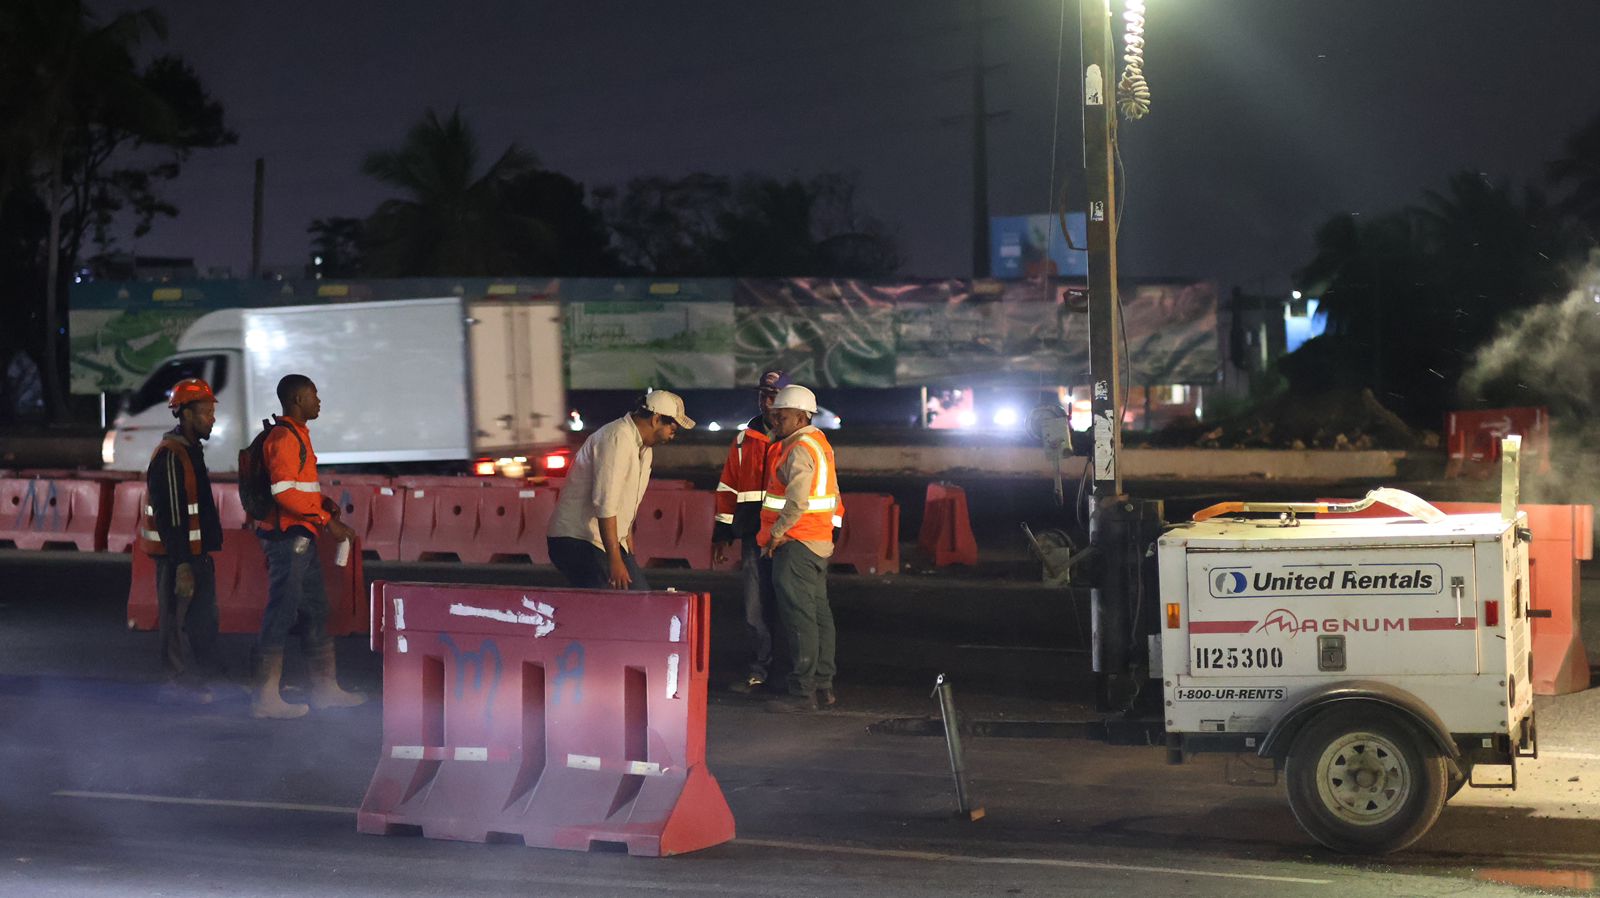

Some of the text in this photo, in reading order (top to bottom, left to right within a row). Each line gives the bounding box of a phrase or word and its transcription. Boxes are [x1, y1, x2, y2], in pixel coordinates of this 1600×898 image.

[1253, 570, 1433, 591] United Rentals
[1256, 608, 1405, 640] MAGNUM
[1177, 689, 1284, 700] 1-800-UR-RENTS
